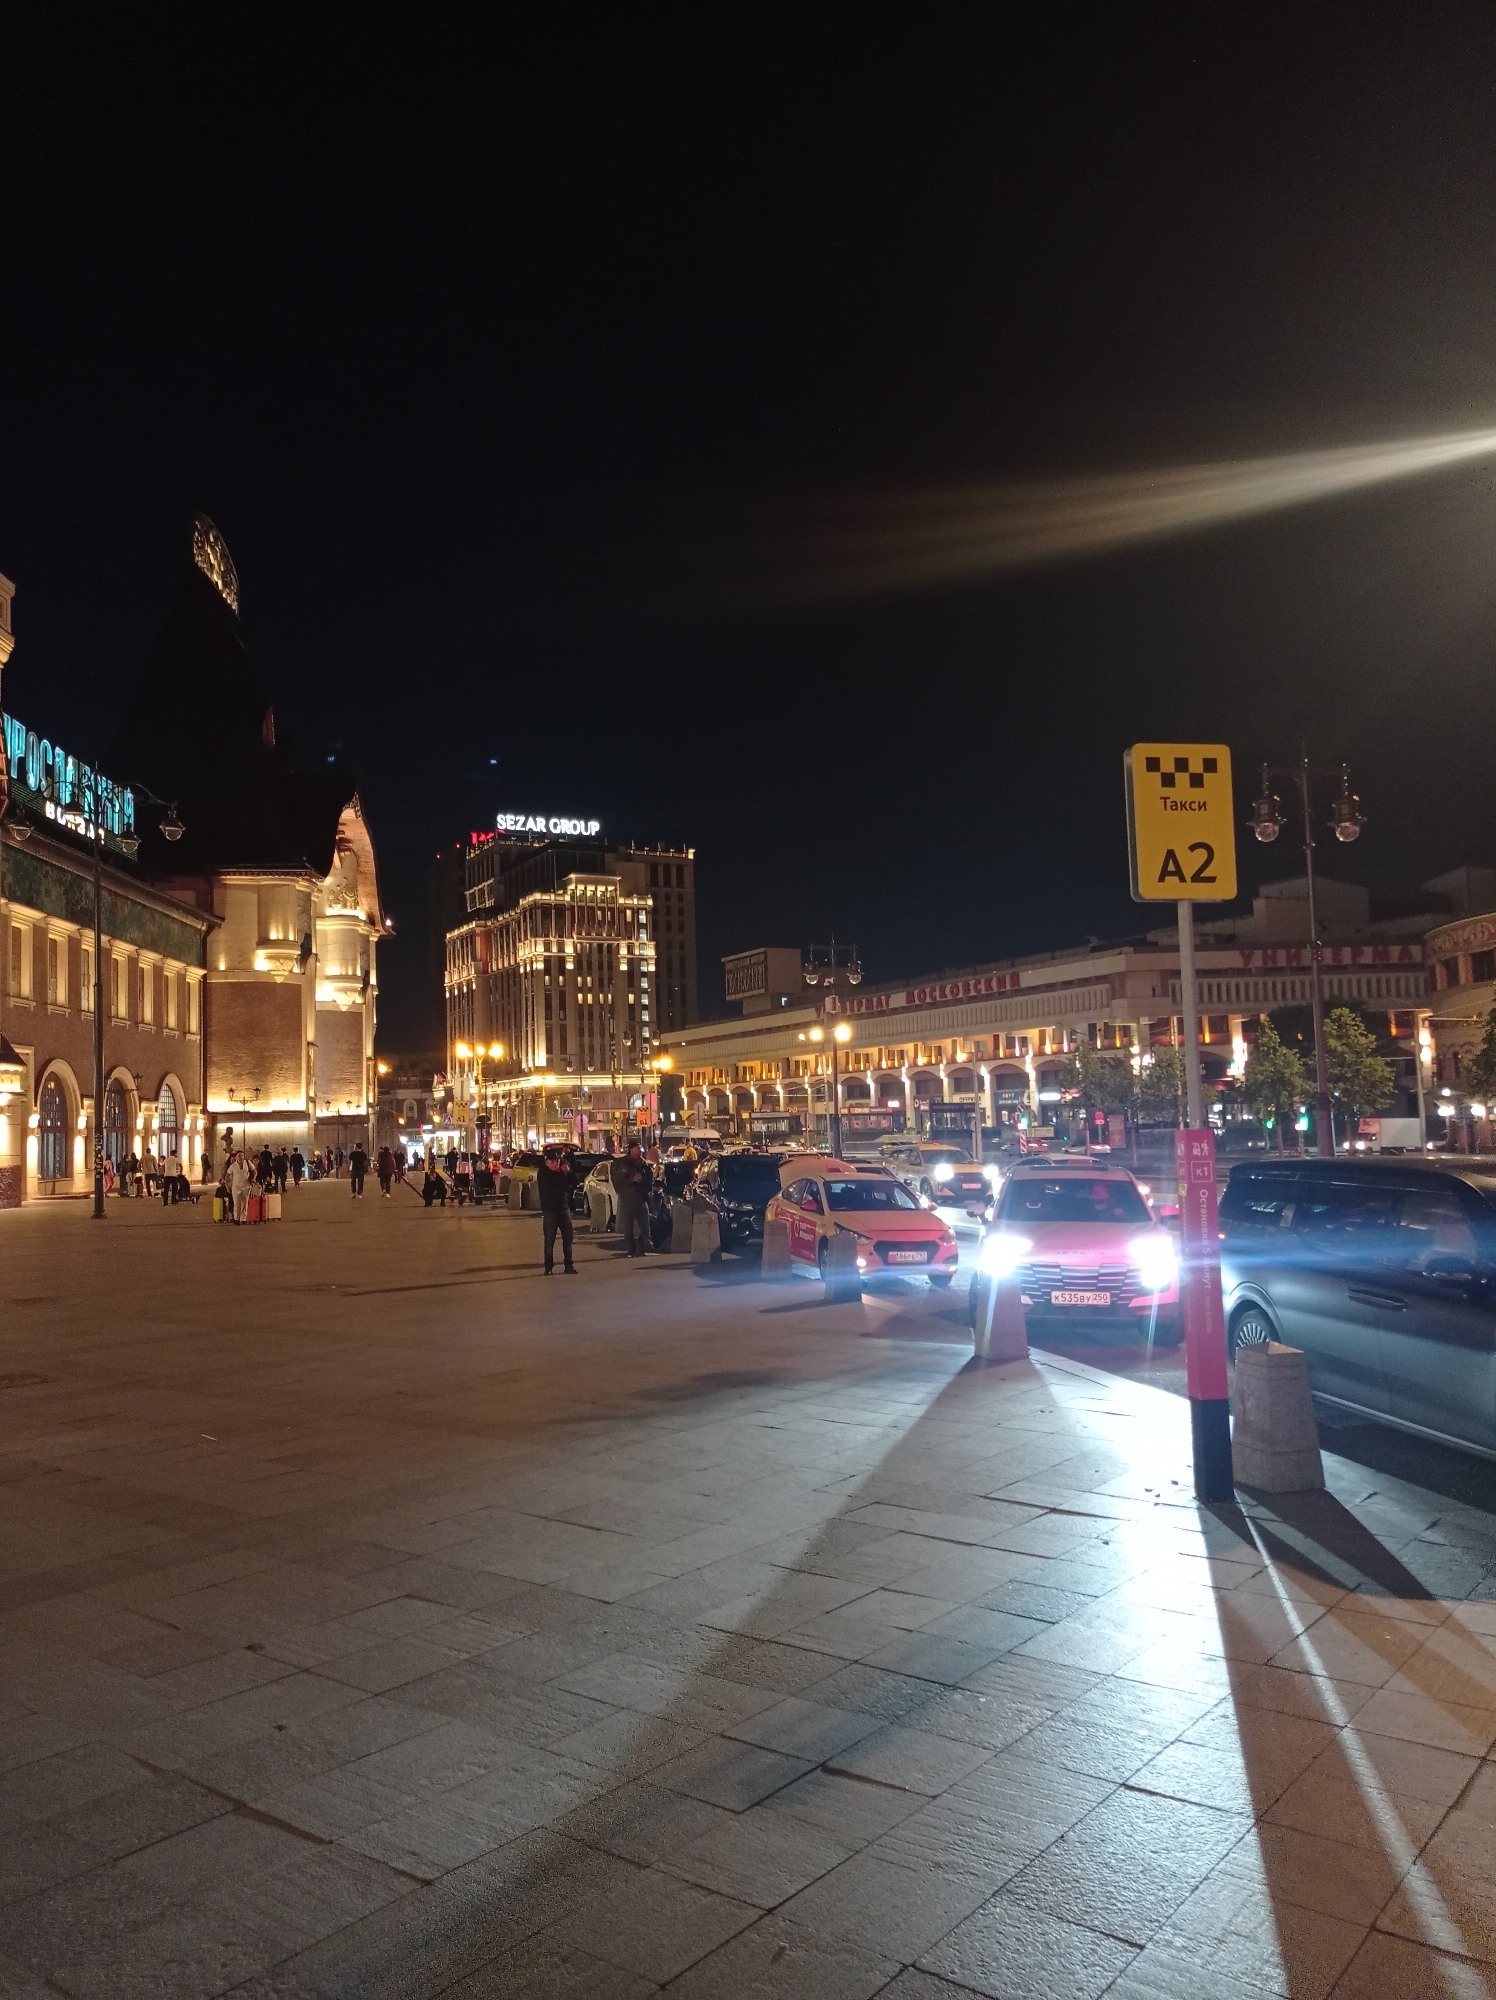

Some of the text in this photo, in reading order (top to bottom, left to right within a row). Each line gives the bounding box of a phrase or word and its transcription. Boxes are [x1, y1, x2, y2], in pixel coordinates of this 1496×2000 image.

[1159, 796, 1208, 812] Такси
[496, 813, 601, 836] SEZAR GROUP
[1157, 841, 1218, 884] А2
[1198, 1188, 1211, 1245] Остановка
[1202, 1247, 1211, 1255] 5
[1093, 1293, 1108, 1301] 250
